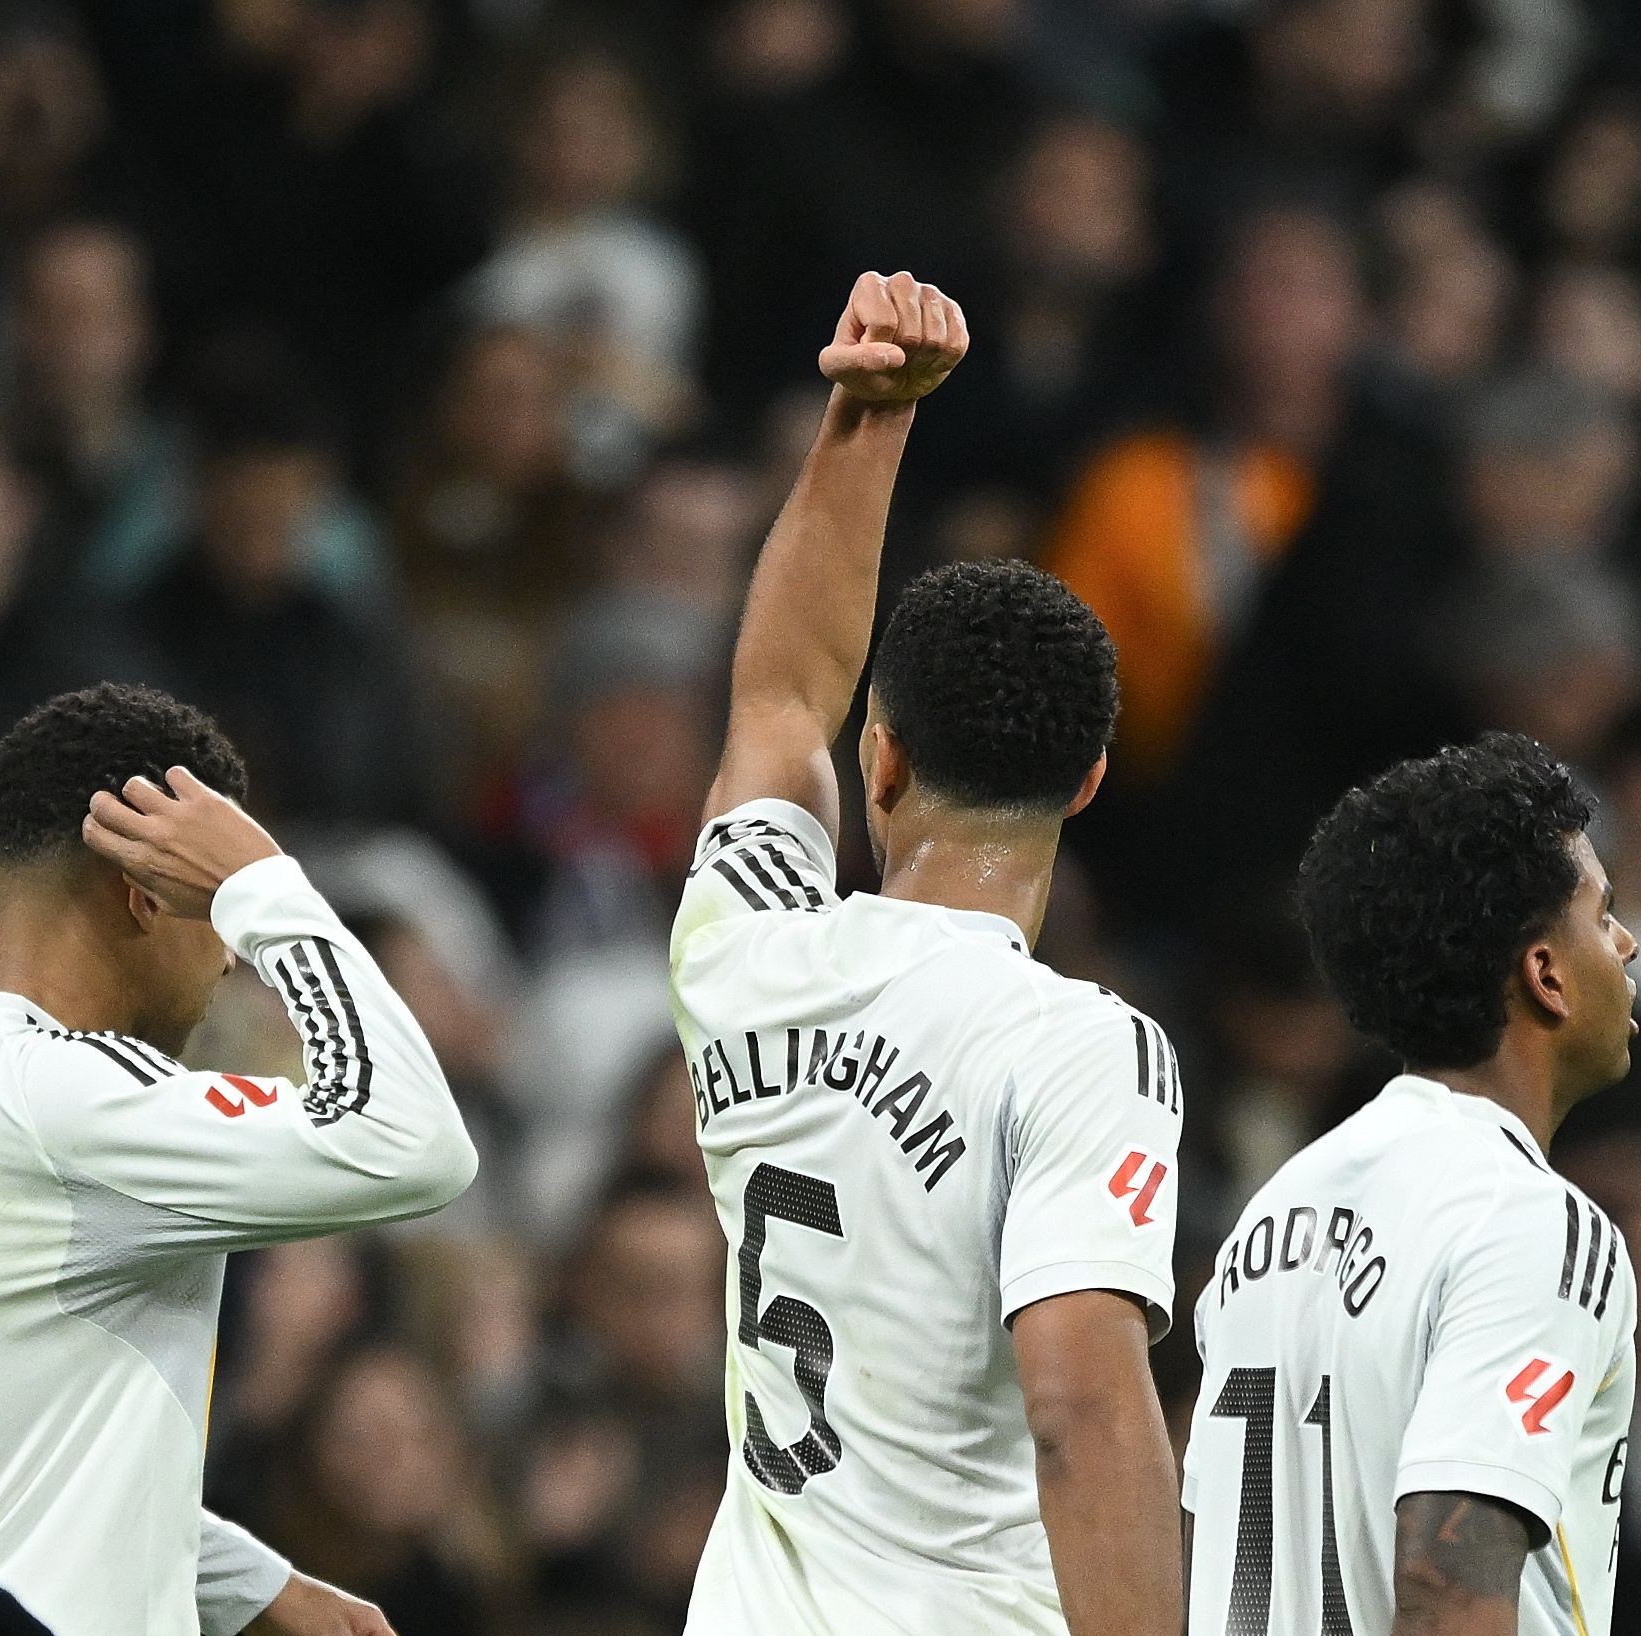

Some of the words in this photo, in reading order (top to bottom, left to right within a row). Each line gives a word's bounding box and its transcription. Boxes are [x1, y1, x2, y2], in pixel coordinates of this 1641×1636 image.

[691, 1027, 967, 1194] BELLINGHAM
[736, 1161, 845, 1497] 5
[1220, 1206, 1387, 1319] RODRGO
